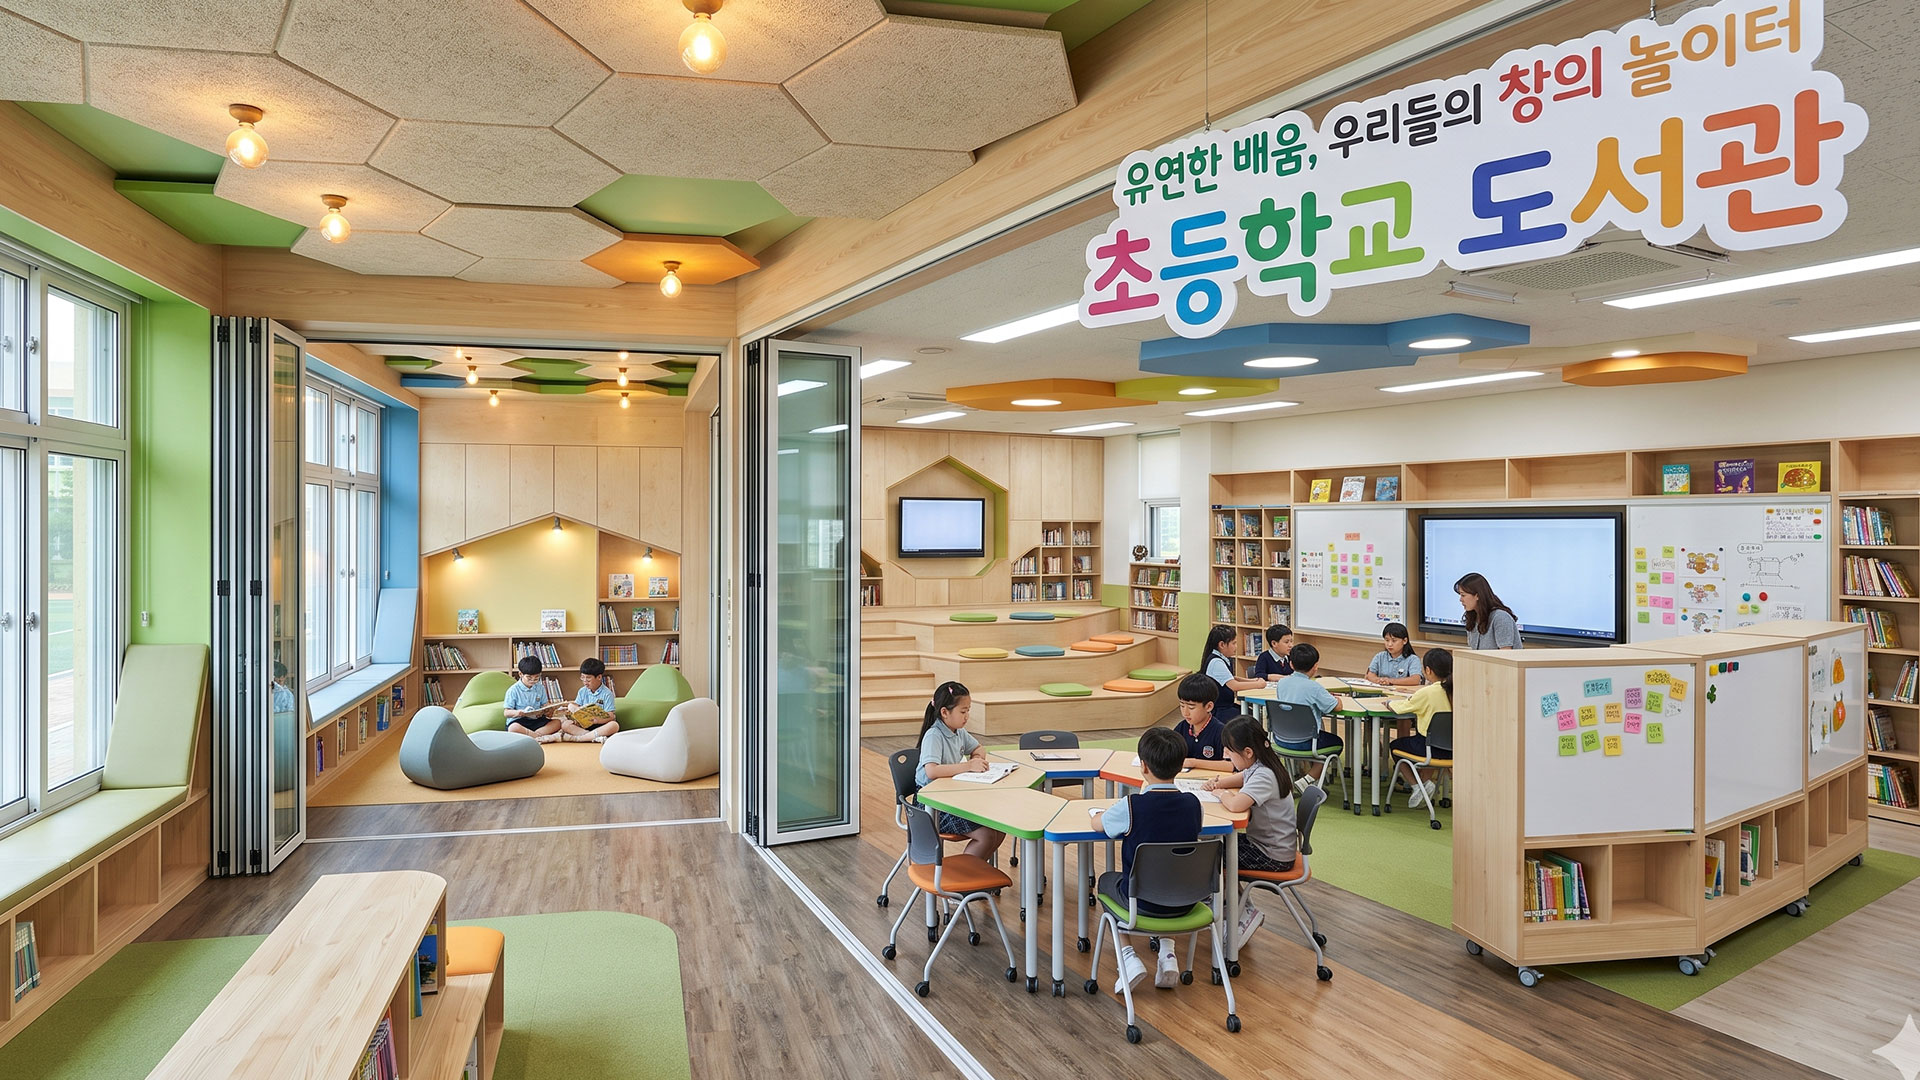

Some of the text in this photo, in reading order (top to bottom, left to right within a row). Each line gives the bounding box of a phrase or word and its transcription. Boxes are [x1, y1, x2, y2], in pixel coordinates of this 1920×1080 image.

[1088, 89, 1844, 326] 초등학교 도서관
[1123, 0, 1800, 206] 유연한 배움, 우리들의 창의 놀이터
